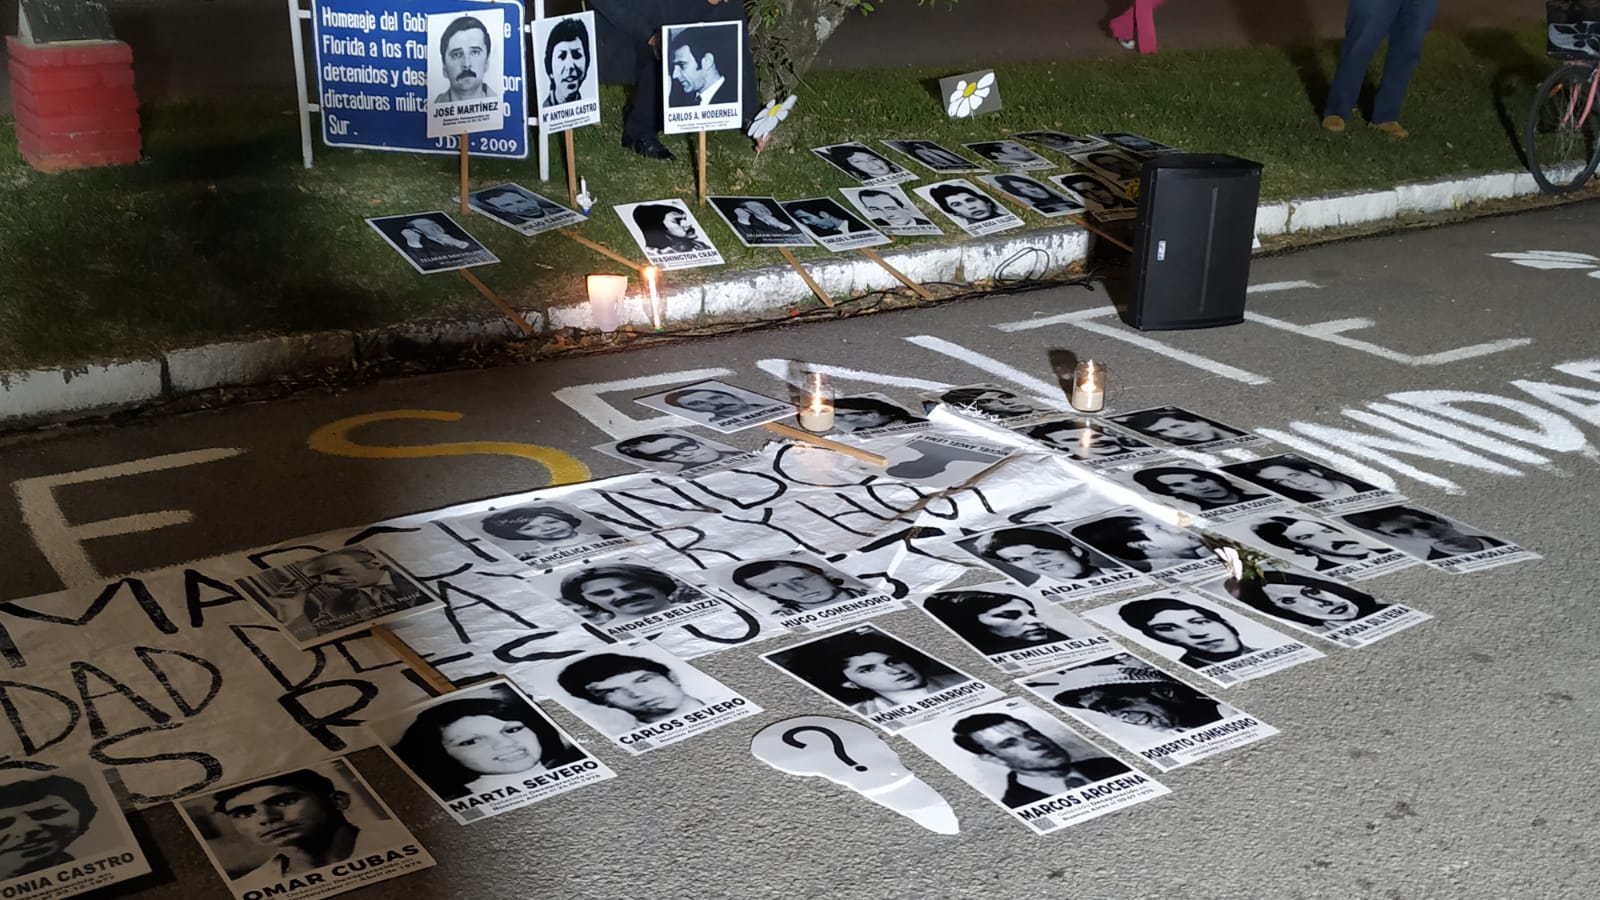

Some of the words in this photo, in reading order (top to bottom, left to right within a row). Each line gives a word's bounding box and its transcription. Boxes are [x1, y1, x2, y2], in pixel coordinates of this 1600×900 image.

[322, 7, 376, 33] Homenaje
[380, 12, 398, 31] del
[323, 35, 365, 57] Florida
[369, 41, 377, 57] a
[382, 38, 402, 59] los
[323, 63, 389, 84] detenidos
[391, 70, 399, 88] y
[324, 89, 391, 111] dictaduras
[395, 95, 429, 113] milita
[433, 104, 455, 119] JOSÉ
[457, 102, 499, 116] MARTÍNEZ
[550, 107, 575, 121] ANTONIA
[575, 102, 597, 115] CASTRO
[668, 111, 693, 123] CARLOS
[694, 111, 700, 121] A.
[701, 108, 738, 120] MODERNELL
[480, 137, 518, 153] 2009
[651, 253, 698, 264] WASHINGTON
[540, 546, 590, 563] ANGÉLICA
[1040, 583, 1084, 597] AÍDA
[1087, 571, 1141, 587] SANZ
[663, 599, 722, 620] BELLIZZI
[780, 613, 818, 628] HUGO
[817, 595, 891, 618] GOMENSORO
[1338, 623, 1369, 637] ROSA
[1369, 606, 1411, 627] SILVEIRA
[1010, 644, 1066, 661] EMILIA
[1066, 636, 1109, 650] ISLAS
[870, 701, 920, 725] MÓNICA
[918, 681, 986, 711] BENARROYO
[619, 718, 684, 745] CARLOS
[684, 697, 746, 723] SEVERO
[1140, 736, 1195, 761] ROBERTO
[448, 785, 521, 813] MARTA
[522, 760, 599, 790] SEVERO
[1017, 794, 1083, 822] MARCOS
[1083, 774, 1150, 803] AROCENA
[57, 852, 135, 882] CASTRO
[242, 872, 326, 900] OMAR
[331, 844, 421, 878] CUBAS
